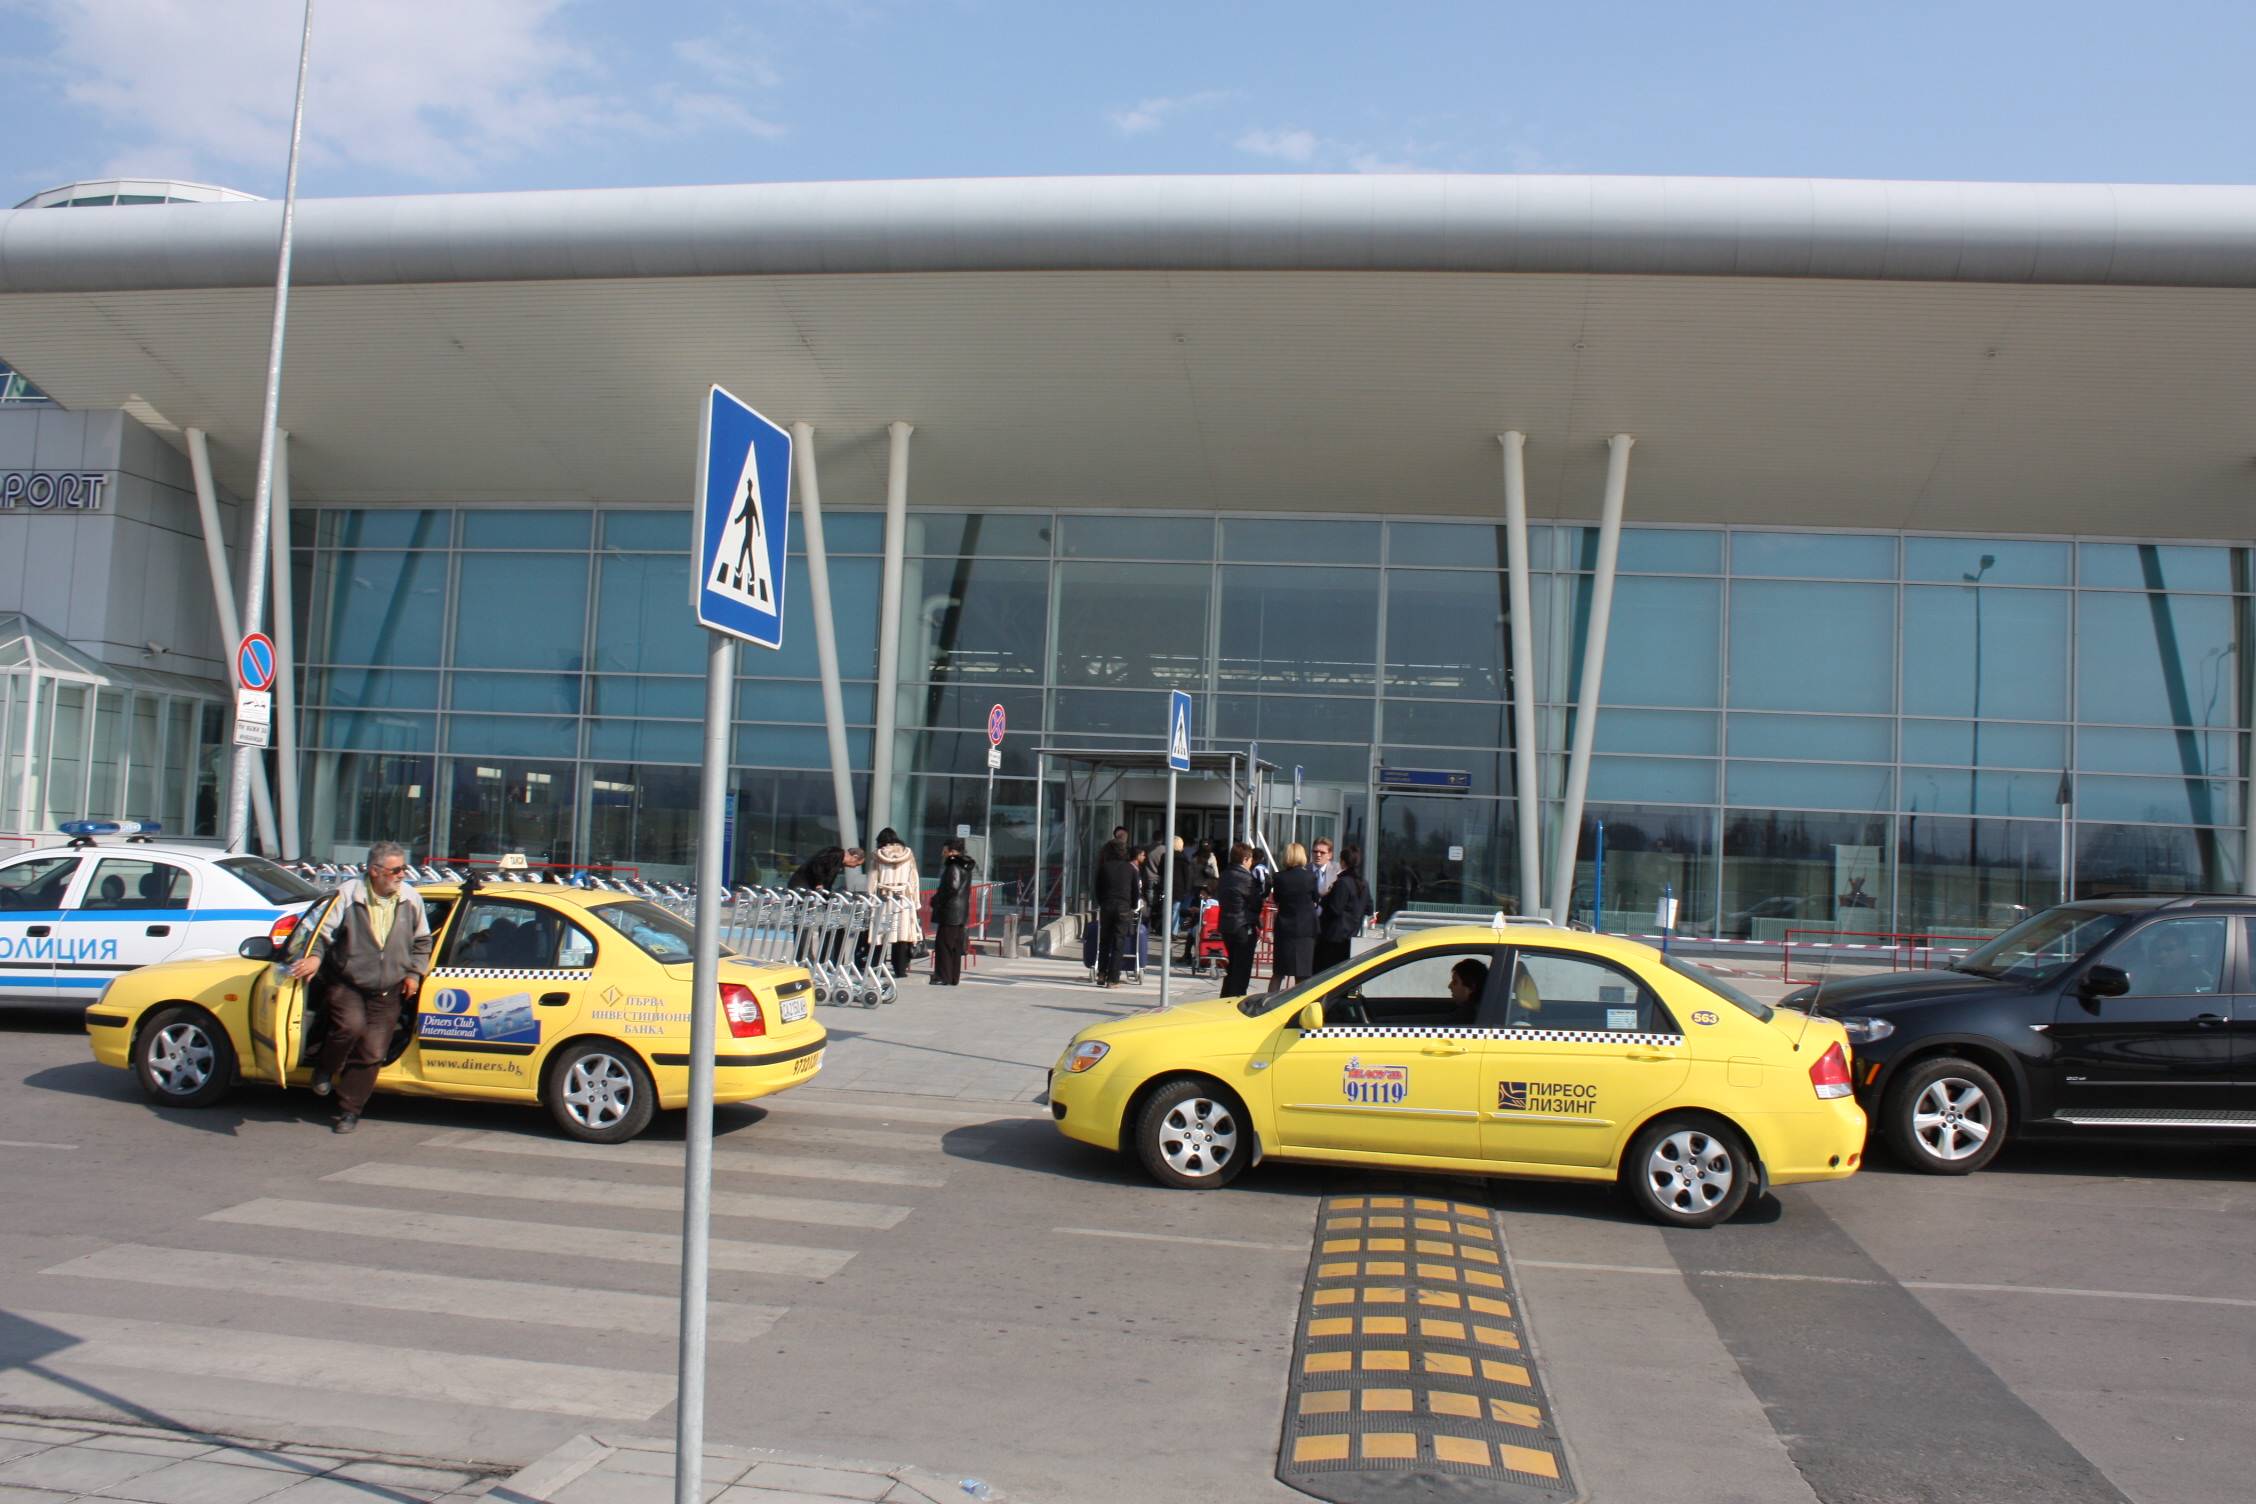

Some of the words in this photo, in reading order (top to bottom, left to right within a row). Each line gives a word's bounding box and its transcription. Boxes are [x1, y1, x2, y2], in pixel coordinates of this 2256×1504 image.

[626, 996, 664, 1006] ПЪРВА
[424, 1015, 452, 1027] Diners
[453, 1016, 475, 1028] Club
[592, 1010, 692, 1022] ИНВЕСТИЦИОНН
[1694, 1012, 1717, 1023] 563
[421, 1025, 477, 1038] International
[624, 1024, 664, 1034] БАНКА
[427, 1059, 523, 1075] www.diners.bg
[1347, 1081, 1403, 1103] 91119
[1529, 1082, 1597, 1098] ПИРЕОС
[1528, 1098, 1597, 1114] ЛИЗИНГ
